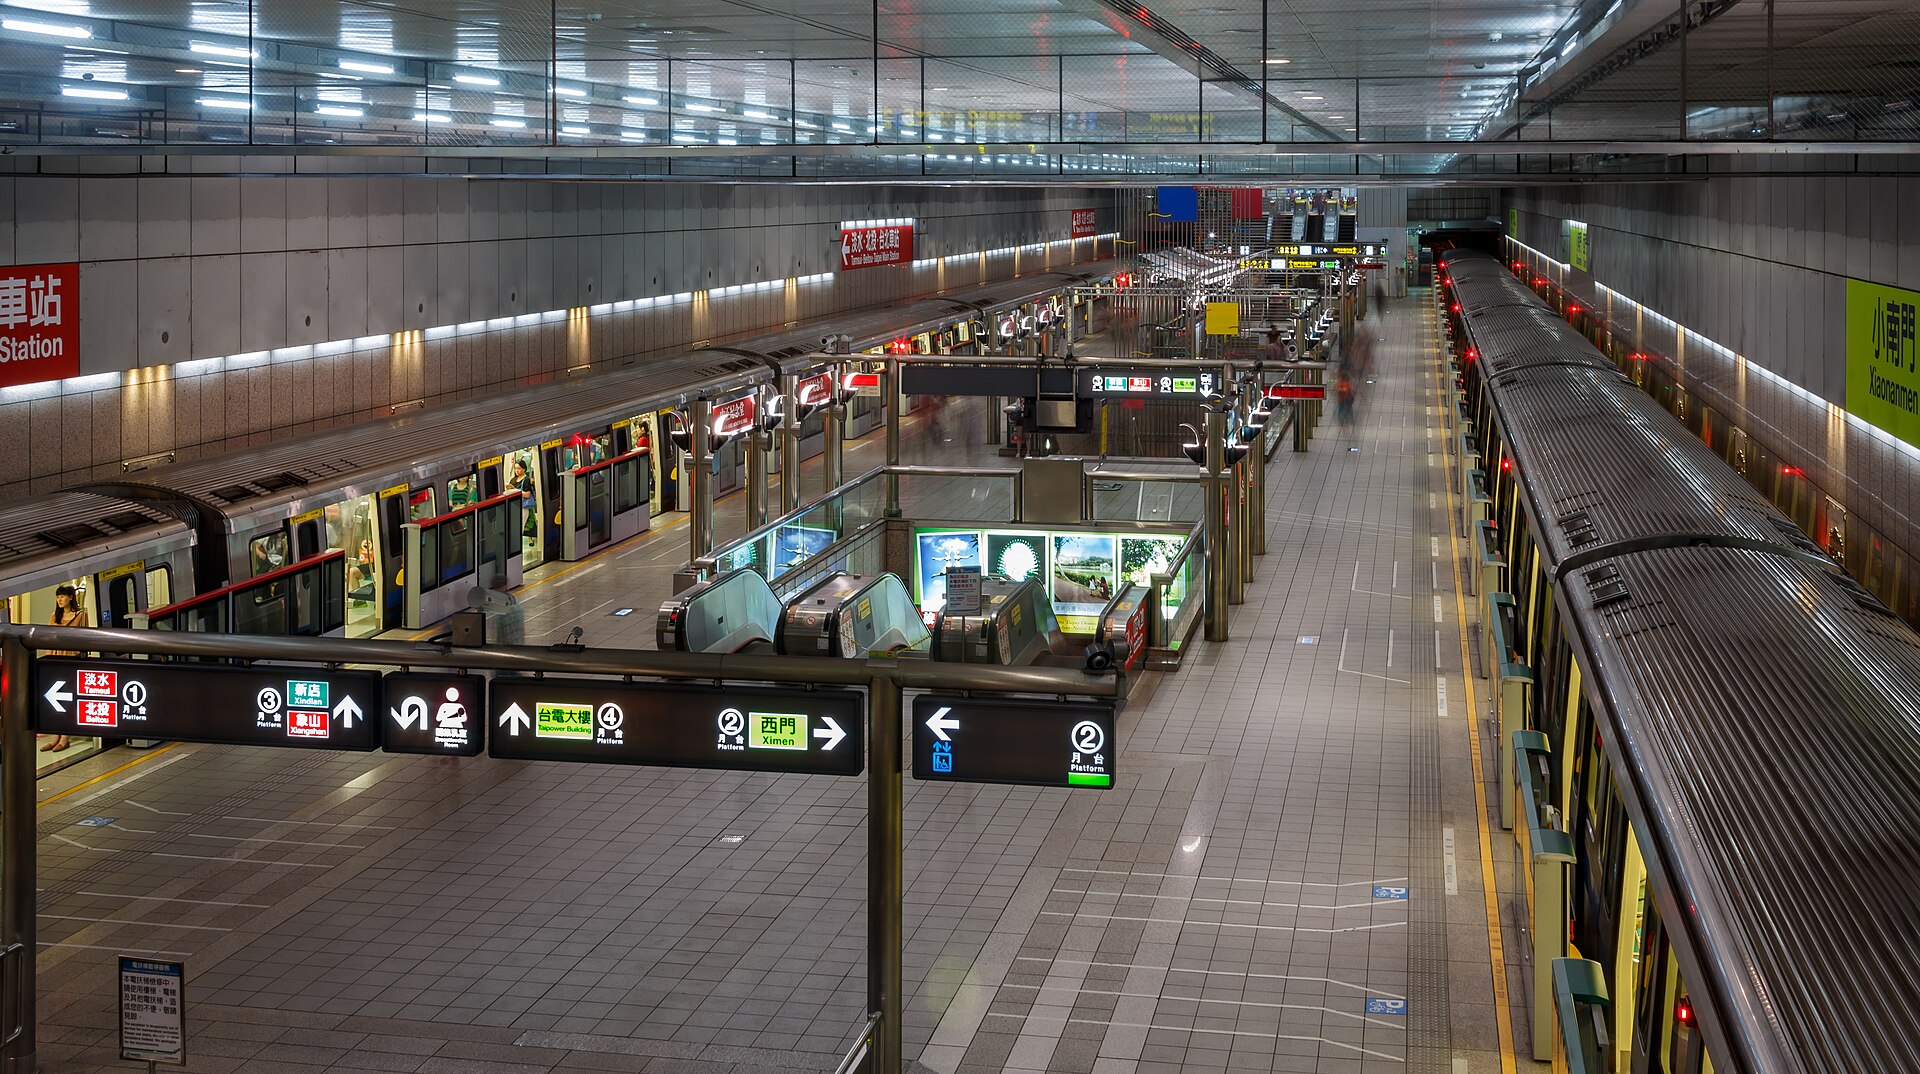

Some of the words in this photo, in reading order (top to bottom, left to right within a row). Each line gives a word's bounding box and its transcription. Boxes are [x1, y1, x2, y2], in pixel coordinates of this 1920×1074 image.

[0, 274, 61, 329] 車站
[1872, 297, 1915, 373] 小南門
[0, 333, 63, 363] Station
[1869, 365, 1919, 416] Xiaonanmen
[85, 672, 109, 686] 淡水
[84, 686, 110, 694] Tamsui
[295, 683, 320, 697] 新店
[294, 697, 323, 705] Xindian
[85, 702, 110, 716] 北投
[538, 708, 591, 724] 台電大樓
[86, 715, 109, 724] Beitou
[761, 716, 796, 735] 西門
[290, 726, 326, 736] Xiangshan
[567, 726, 591, 734] Building
[762, 736, 795, 745] Ximen
[1070, 752, 1105, 765] 月台
[1070, 763, 1105, 773] Platform
